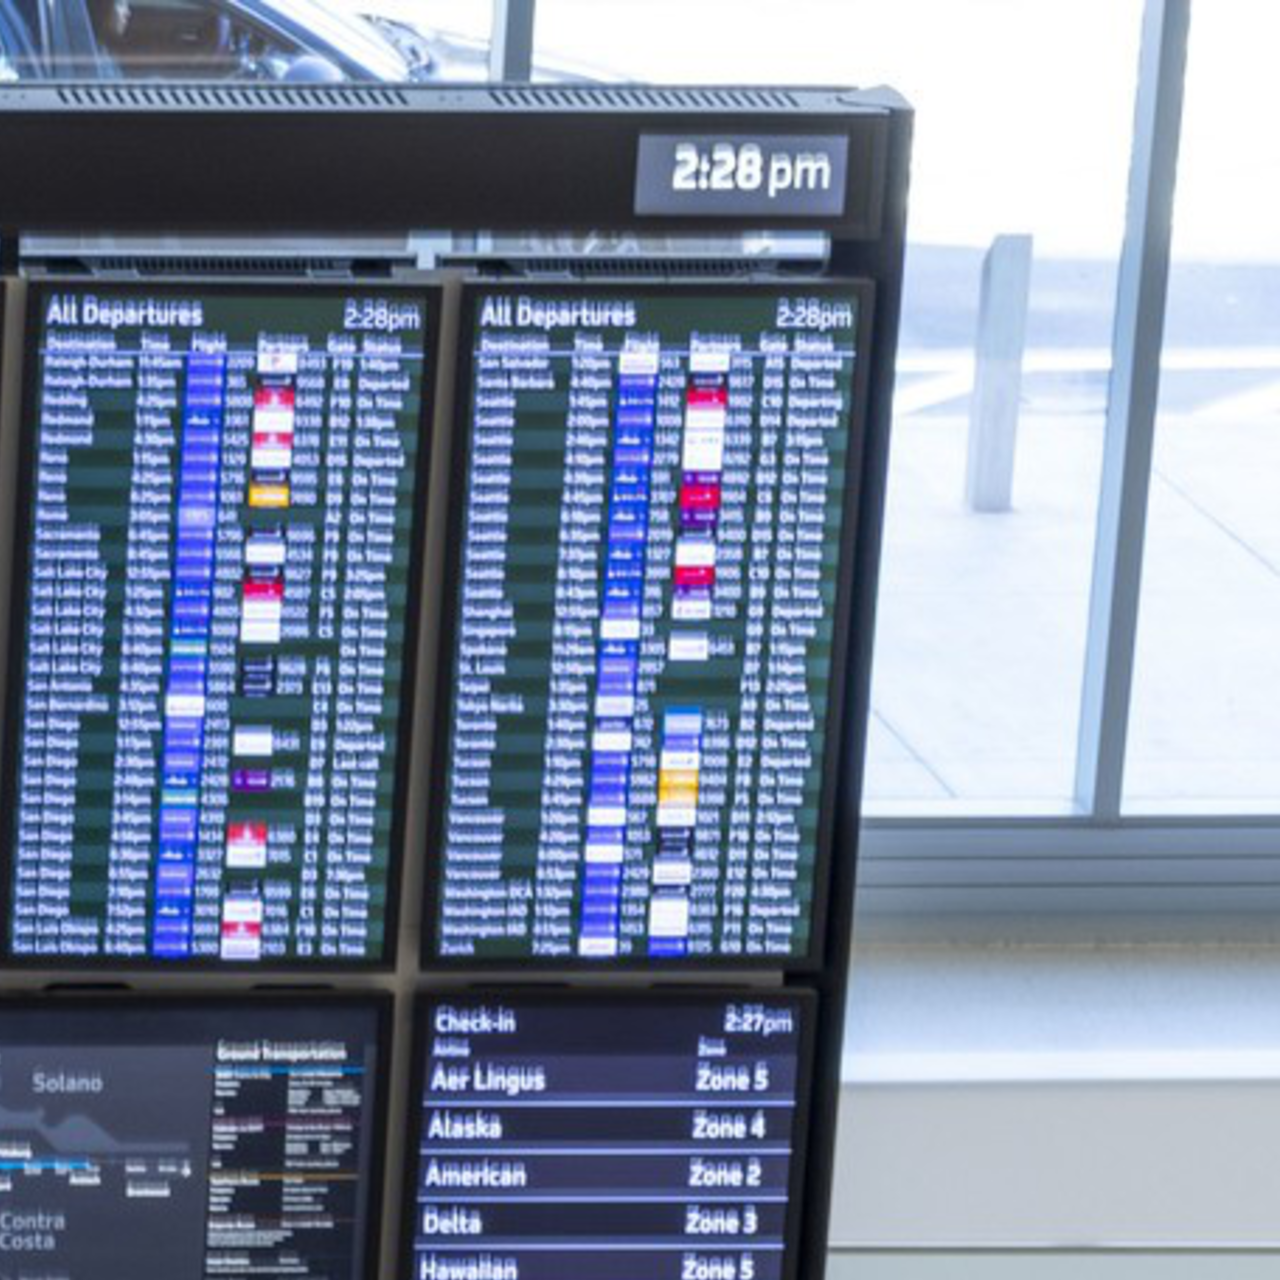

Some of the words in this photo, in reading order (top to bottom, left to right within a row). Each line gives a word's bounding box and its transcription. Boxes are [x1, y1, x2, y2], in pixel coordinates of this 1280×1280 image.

[672, 145, 762, 190] 2:28
[768, 154, 831, 197] pm
[47, 299, 78, 325] All
[83, 299, 203, 329] Departures
[344, 302, 420, 330] 2:28pm
[481, 300, 513, 327] All
[517, 300, 637, 331] Departures
[777, 302, 852, 331] 2:28pm
[435, 1007, 515, 1032] Check-in
[724, 1009, 793, 1035] 2:27pm
[33, 1071, 102, 1093] Solano
[431, 1064, 470, 1091] Aer
[474, 1064, 546, 1096] Lingus
[696, 1062, 749, 1090] Zone
[753, 1063, 769, 1090] 5
[429, 1111, 502, 1138] Alaska
[692, 1111, 746, 1138] Zone
[750, 1111, 766, 1138] 4
[426, 1158, 526, 1186] American
[689, 1158, 742, 1186] Zone
[746, 1158, 761, 1186] 2
[0, 1212, 64, 1231] Contra
[423, 1206, 482, 1234] Delta
[685, 1206, 739, 1234] Zone
[743, 1206, 758, 1234] 3
[0, 1232, 55, 1250] Costa
[420, 1253, 518, 1280] Hawaiian
[682, 1253, 735, 1280] Zone
[739, 1253, 754, 1280] 5
